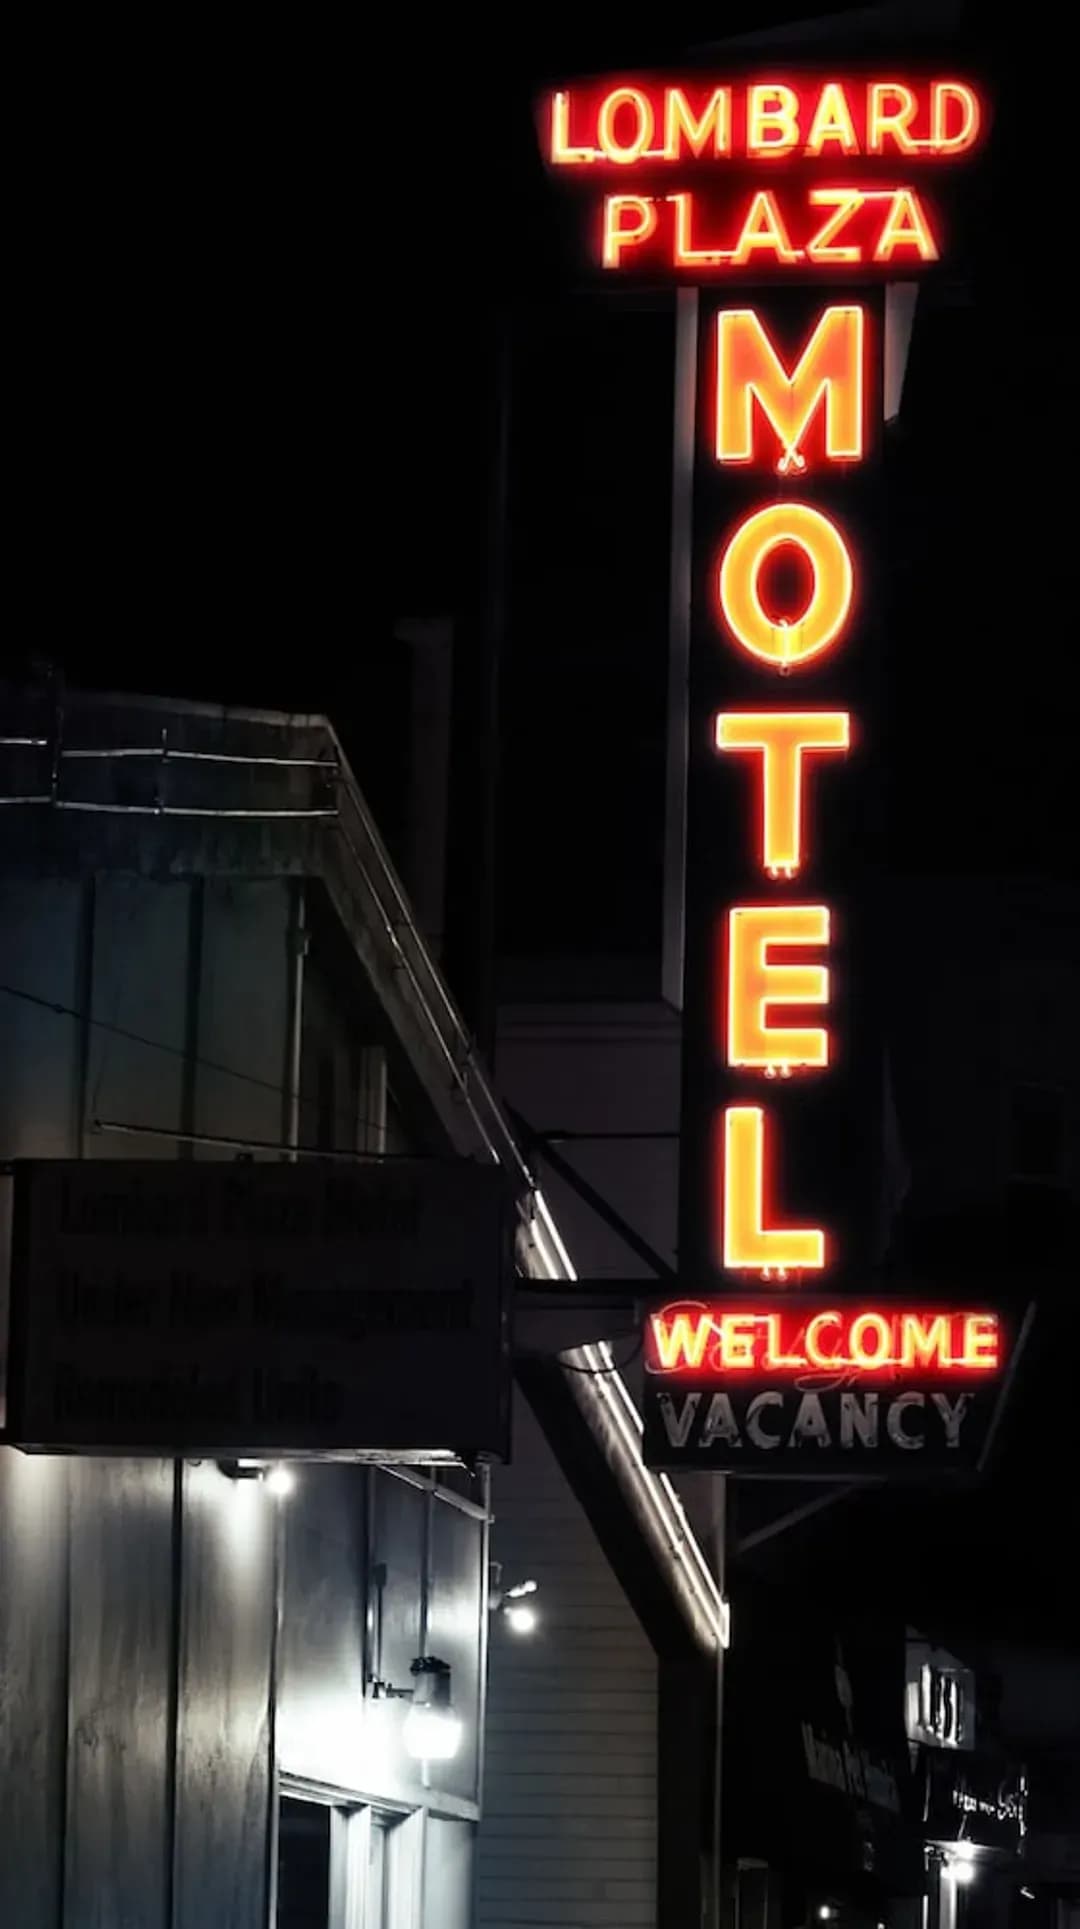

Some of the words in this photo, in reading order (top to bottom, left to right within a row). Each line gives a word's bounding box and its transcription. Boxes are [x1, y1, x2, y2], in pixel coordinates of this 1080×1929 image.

[550, 82, 980, 164] LOMBARD
[602, 187, 939, 268] PLAZA
[714, 305, 866, 1272] MOTEL
[649, 1311, 999, 1369] WELCOME
[656, 1391, 975, 1450] VACANCY
